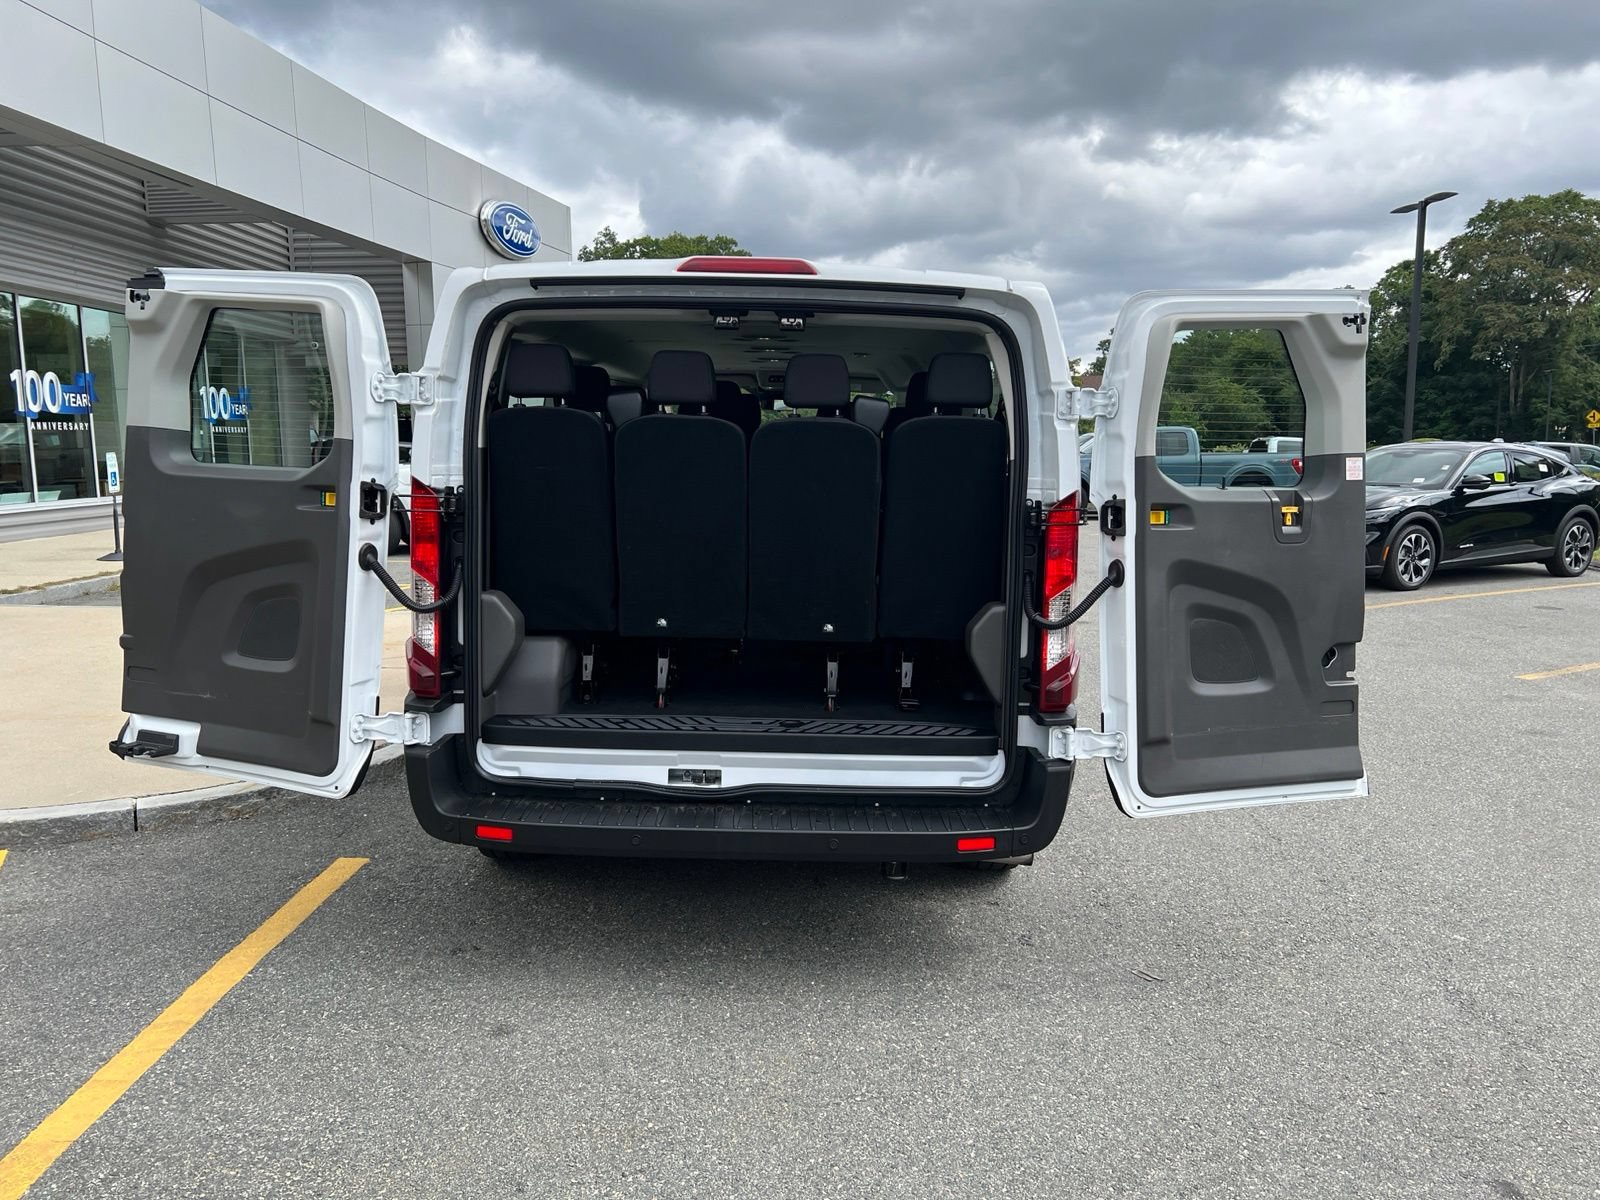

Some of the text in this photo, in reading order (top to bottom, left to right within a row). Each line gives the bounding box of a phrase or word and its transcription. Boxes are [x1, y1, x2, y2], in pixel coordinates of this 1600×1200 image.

[503, 212, 533, 249] Ford
[9, 369, 62, 413] 100
[199, 386, 231, 420] 100
[31, 422, 89, 431] ANNIVERSARY
